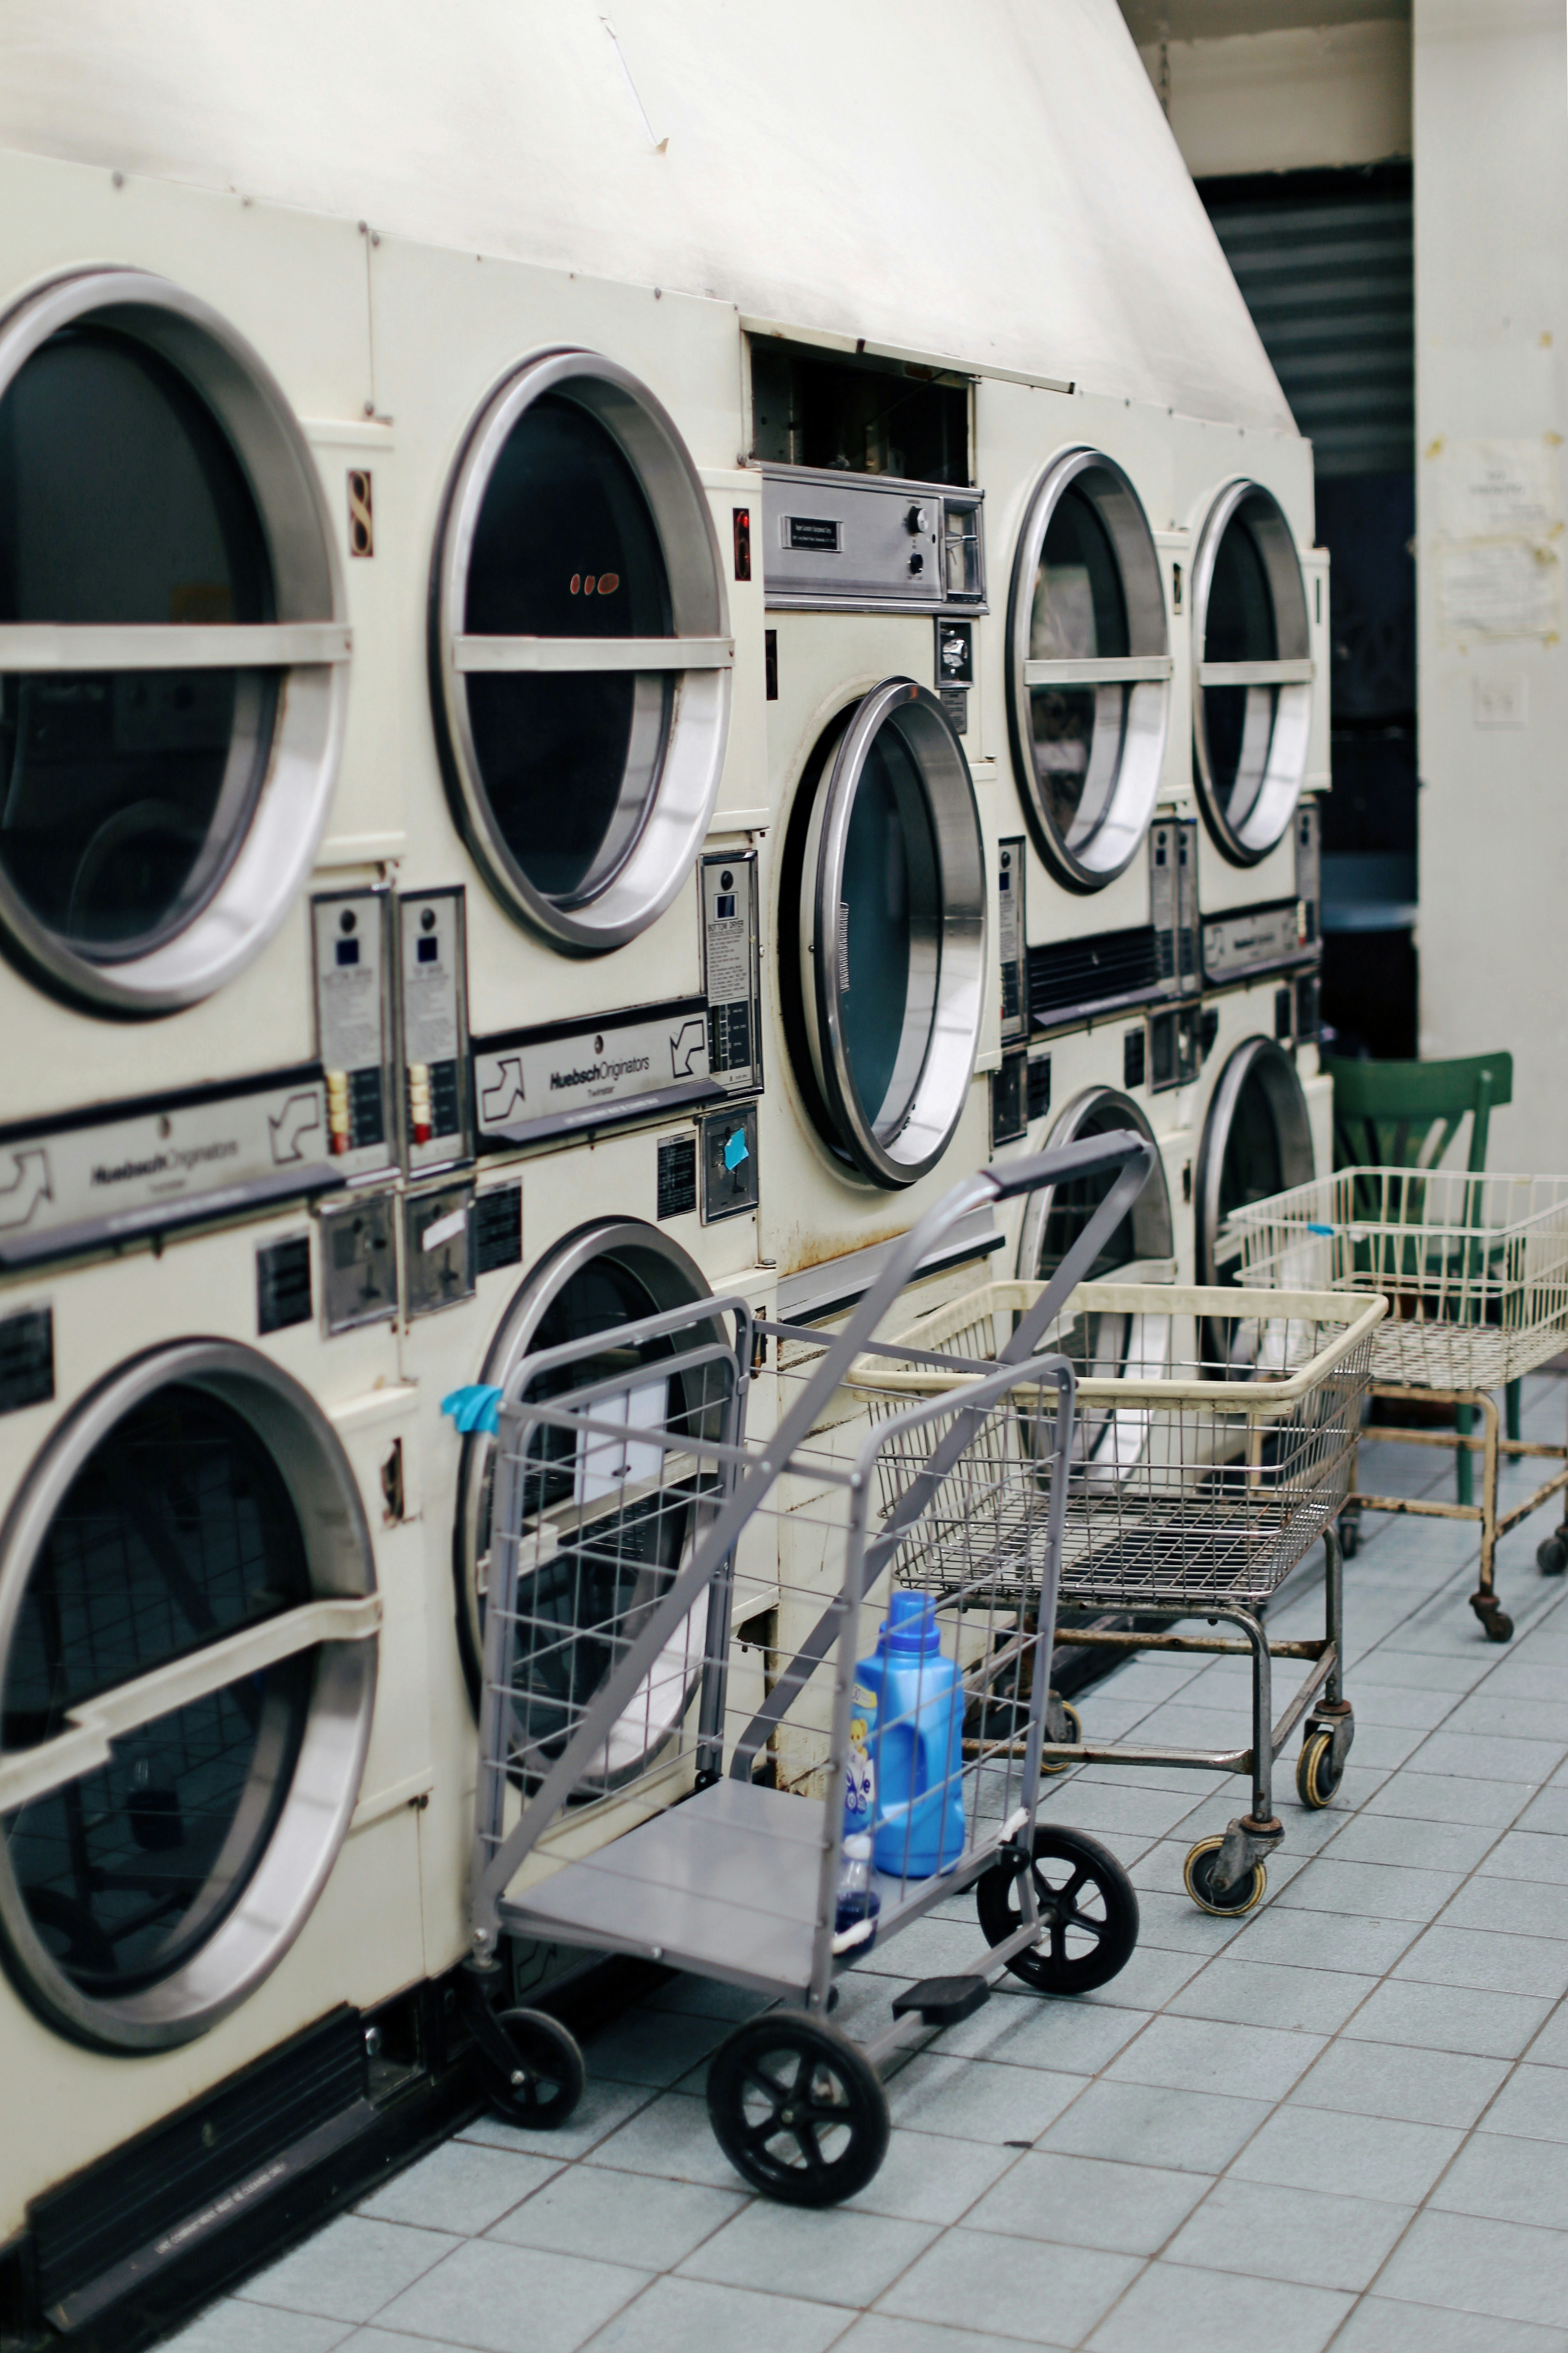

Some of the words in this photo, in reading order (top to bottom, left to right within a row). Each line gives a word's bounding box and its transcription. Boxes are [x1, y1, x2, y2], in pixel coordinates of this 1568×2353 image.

[348, 471, 372, 556] 8
[708, 923, 727, 932] BOTTOM
[730, 920, 744, 929] DRYER
